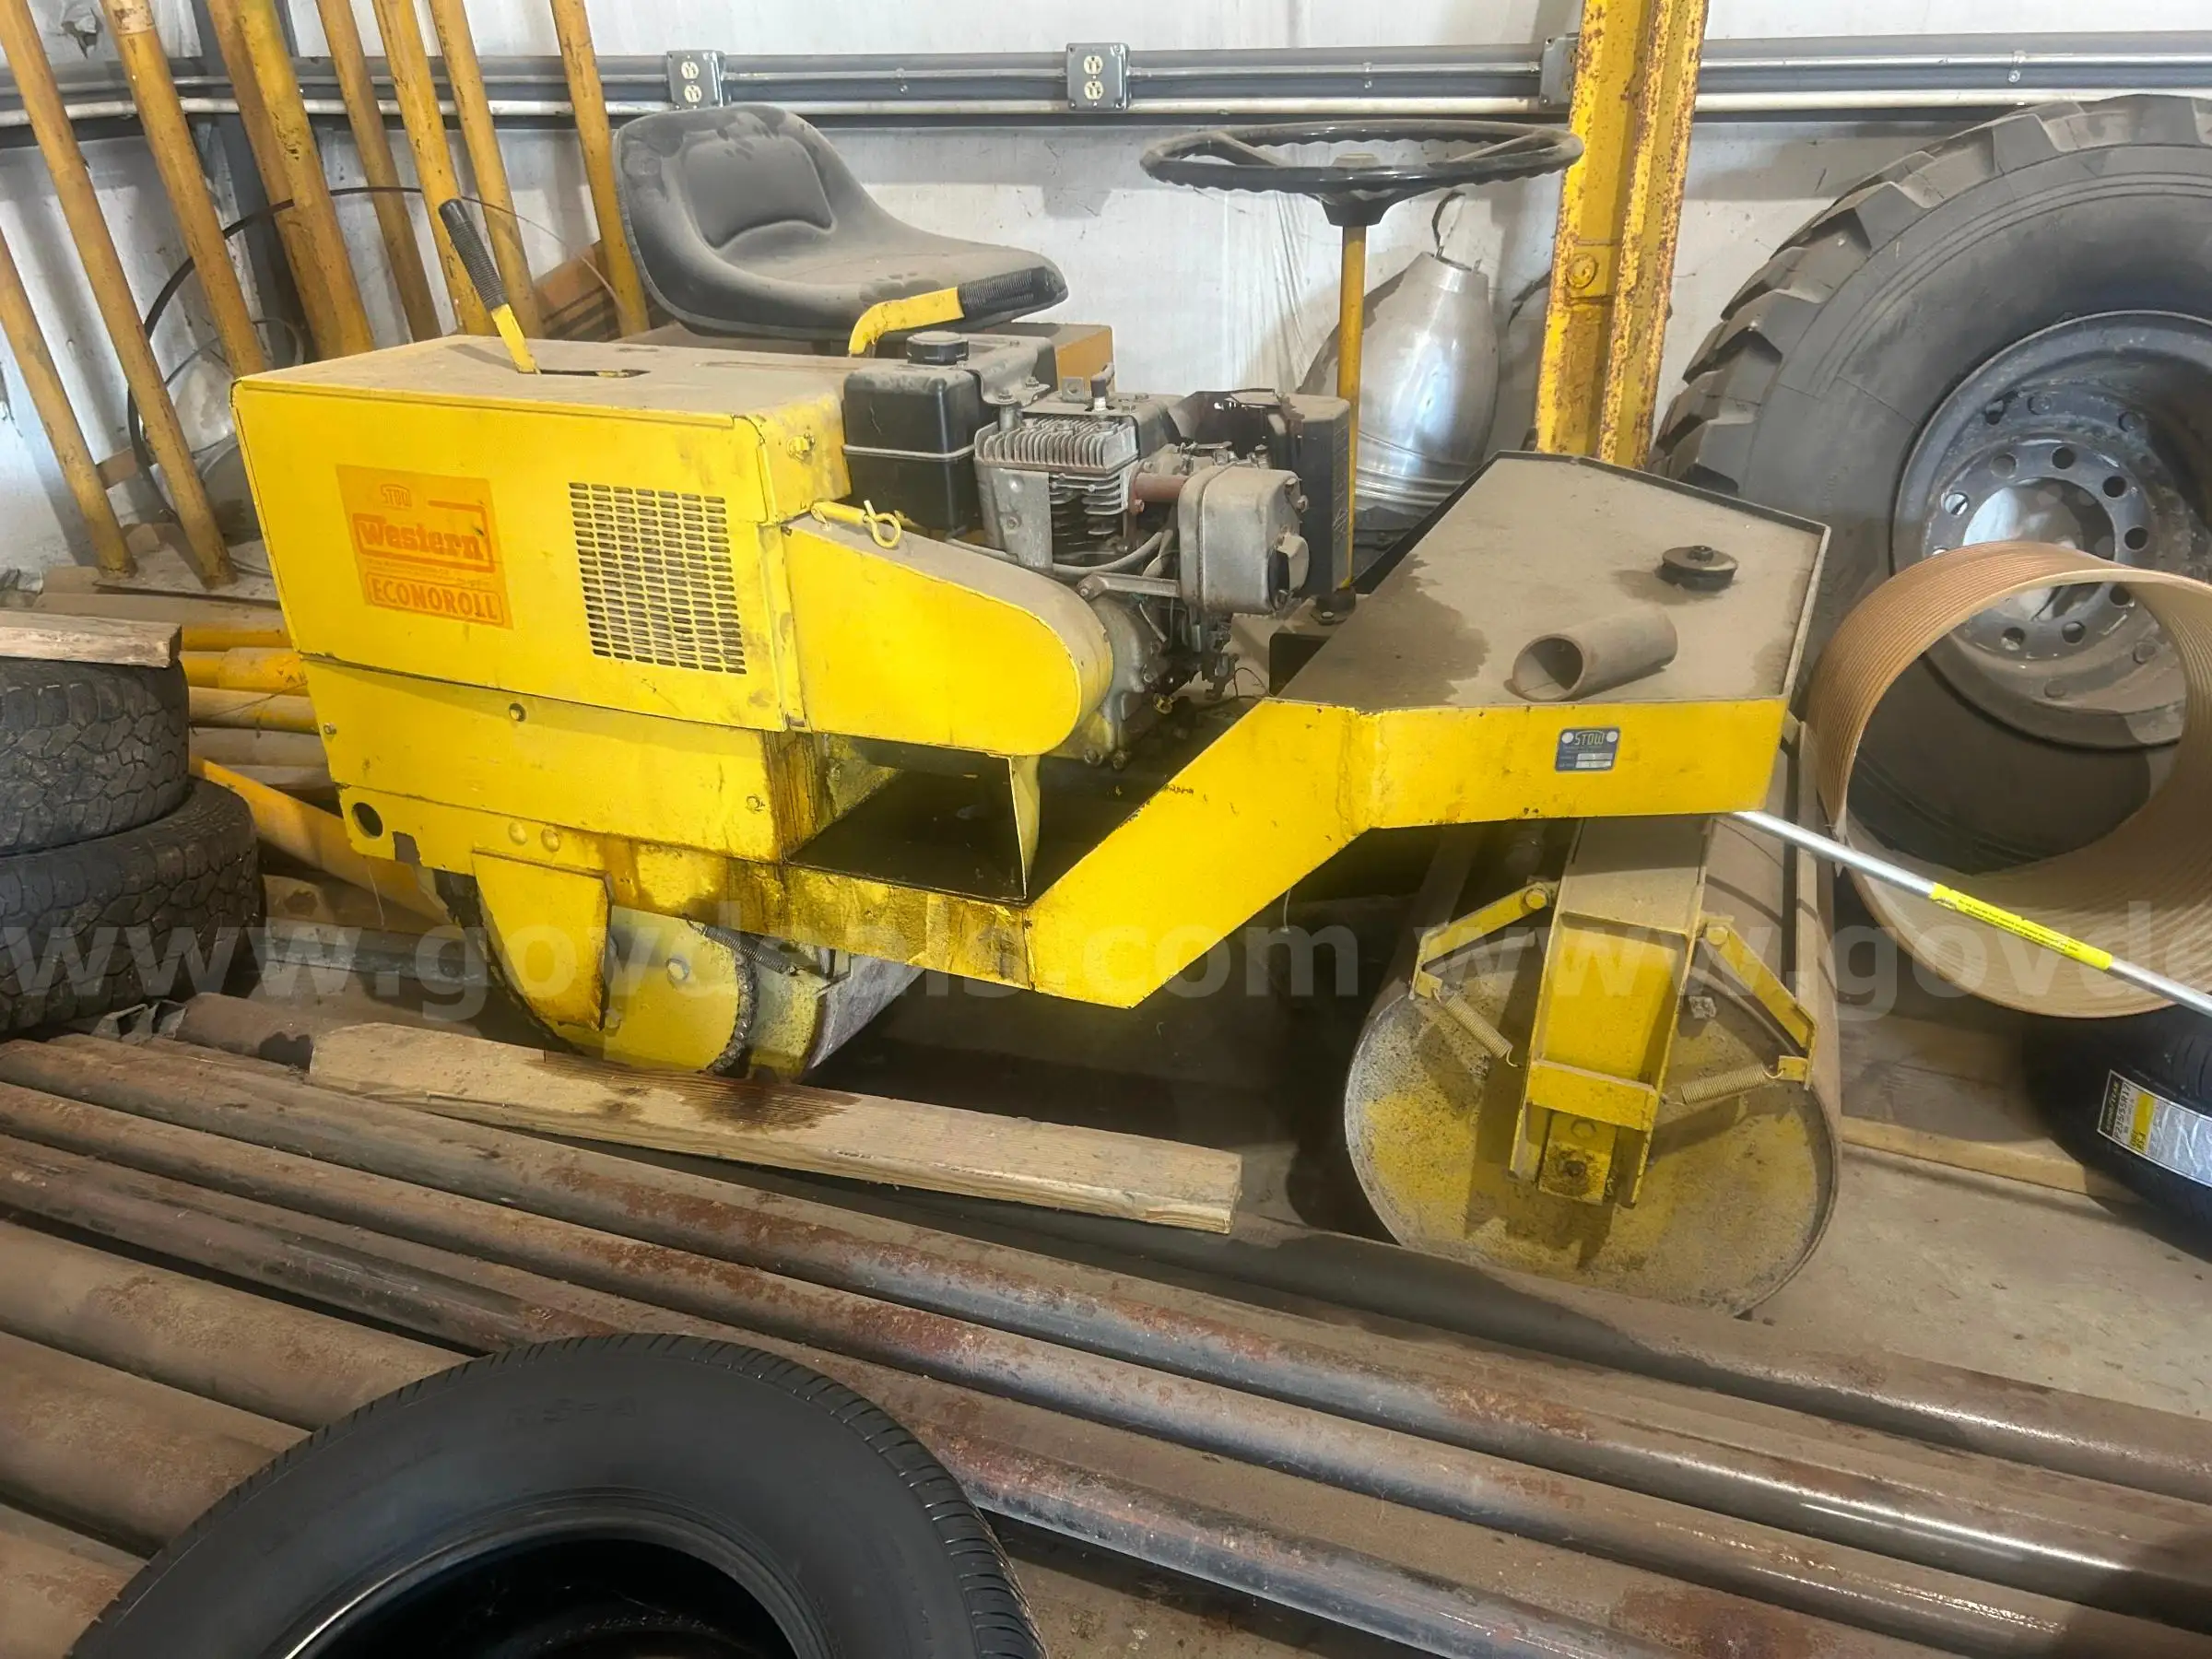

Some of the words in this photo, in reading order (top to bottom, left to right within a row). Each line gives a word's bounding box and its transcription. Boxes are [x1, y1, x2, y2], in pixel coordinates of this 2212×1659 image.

[359, 523, 484, 559] Western
[372, 578, 497, 618] ECONOROLL
[1574, 730, 1605, 745] STOW
